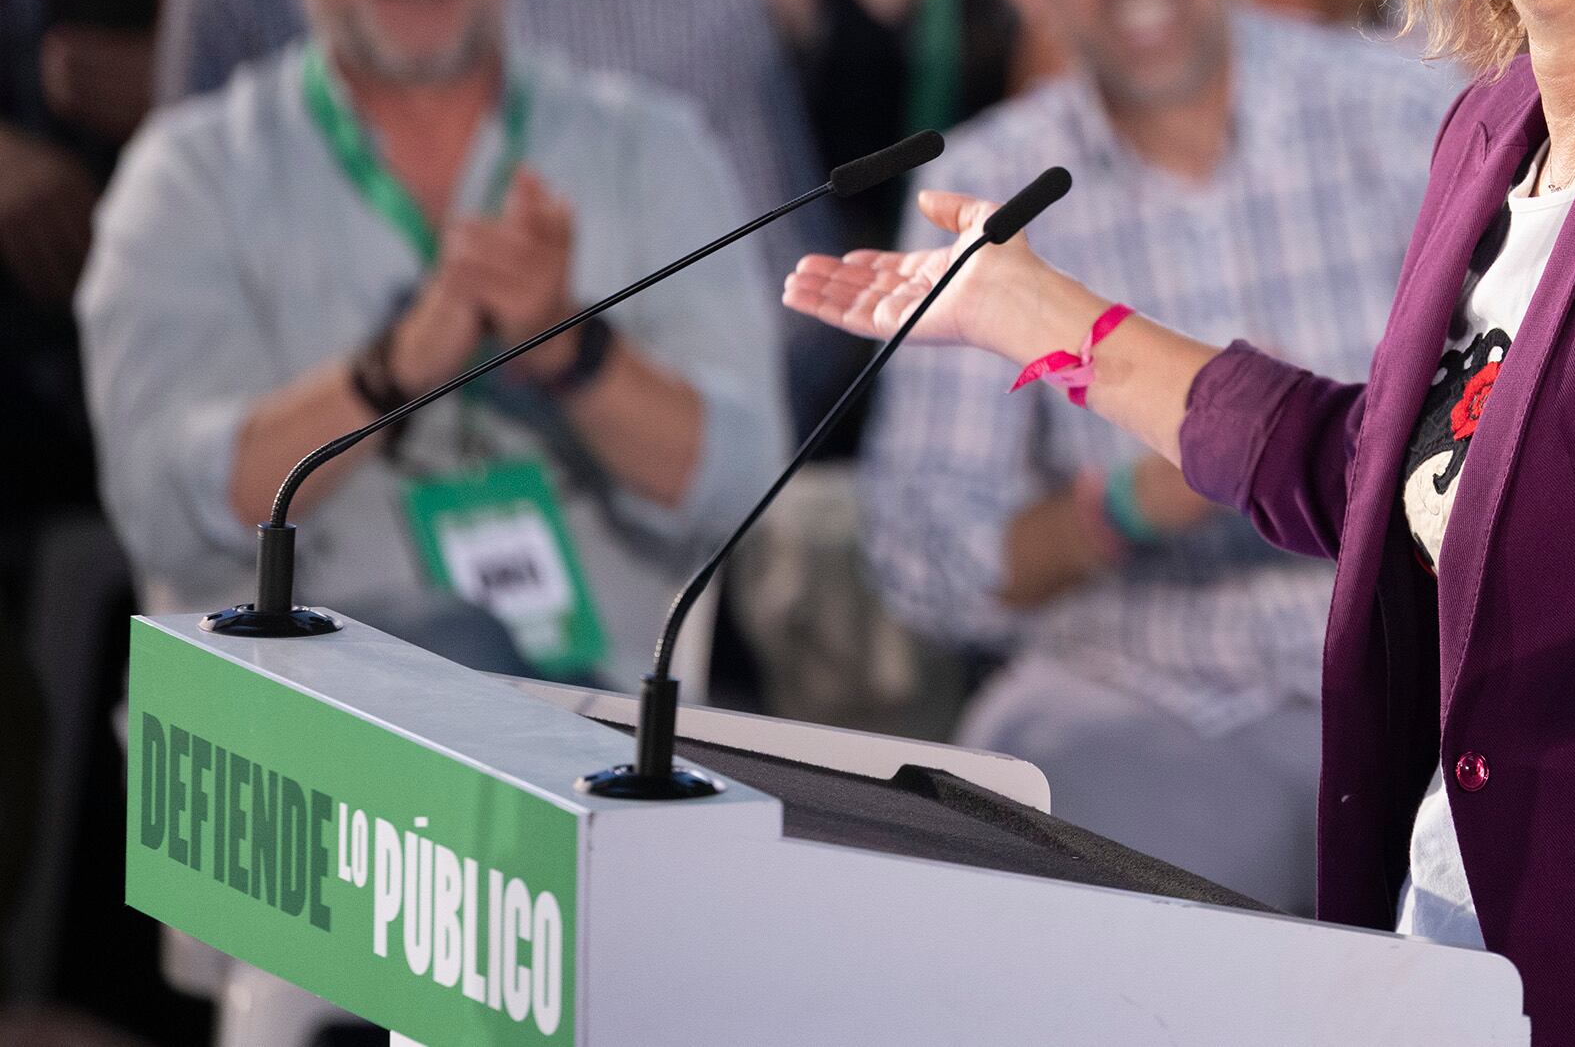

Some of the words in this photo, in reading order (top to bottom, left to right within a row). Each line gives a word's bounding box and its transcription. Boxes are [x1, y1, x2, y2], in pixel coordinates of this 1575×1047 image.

[141, 712, 332, 932] DEFIENDE
[338, 802, 367, 887] LO
[373, 817, 562, 1036] PÚBLICO
